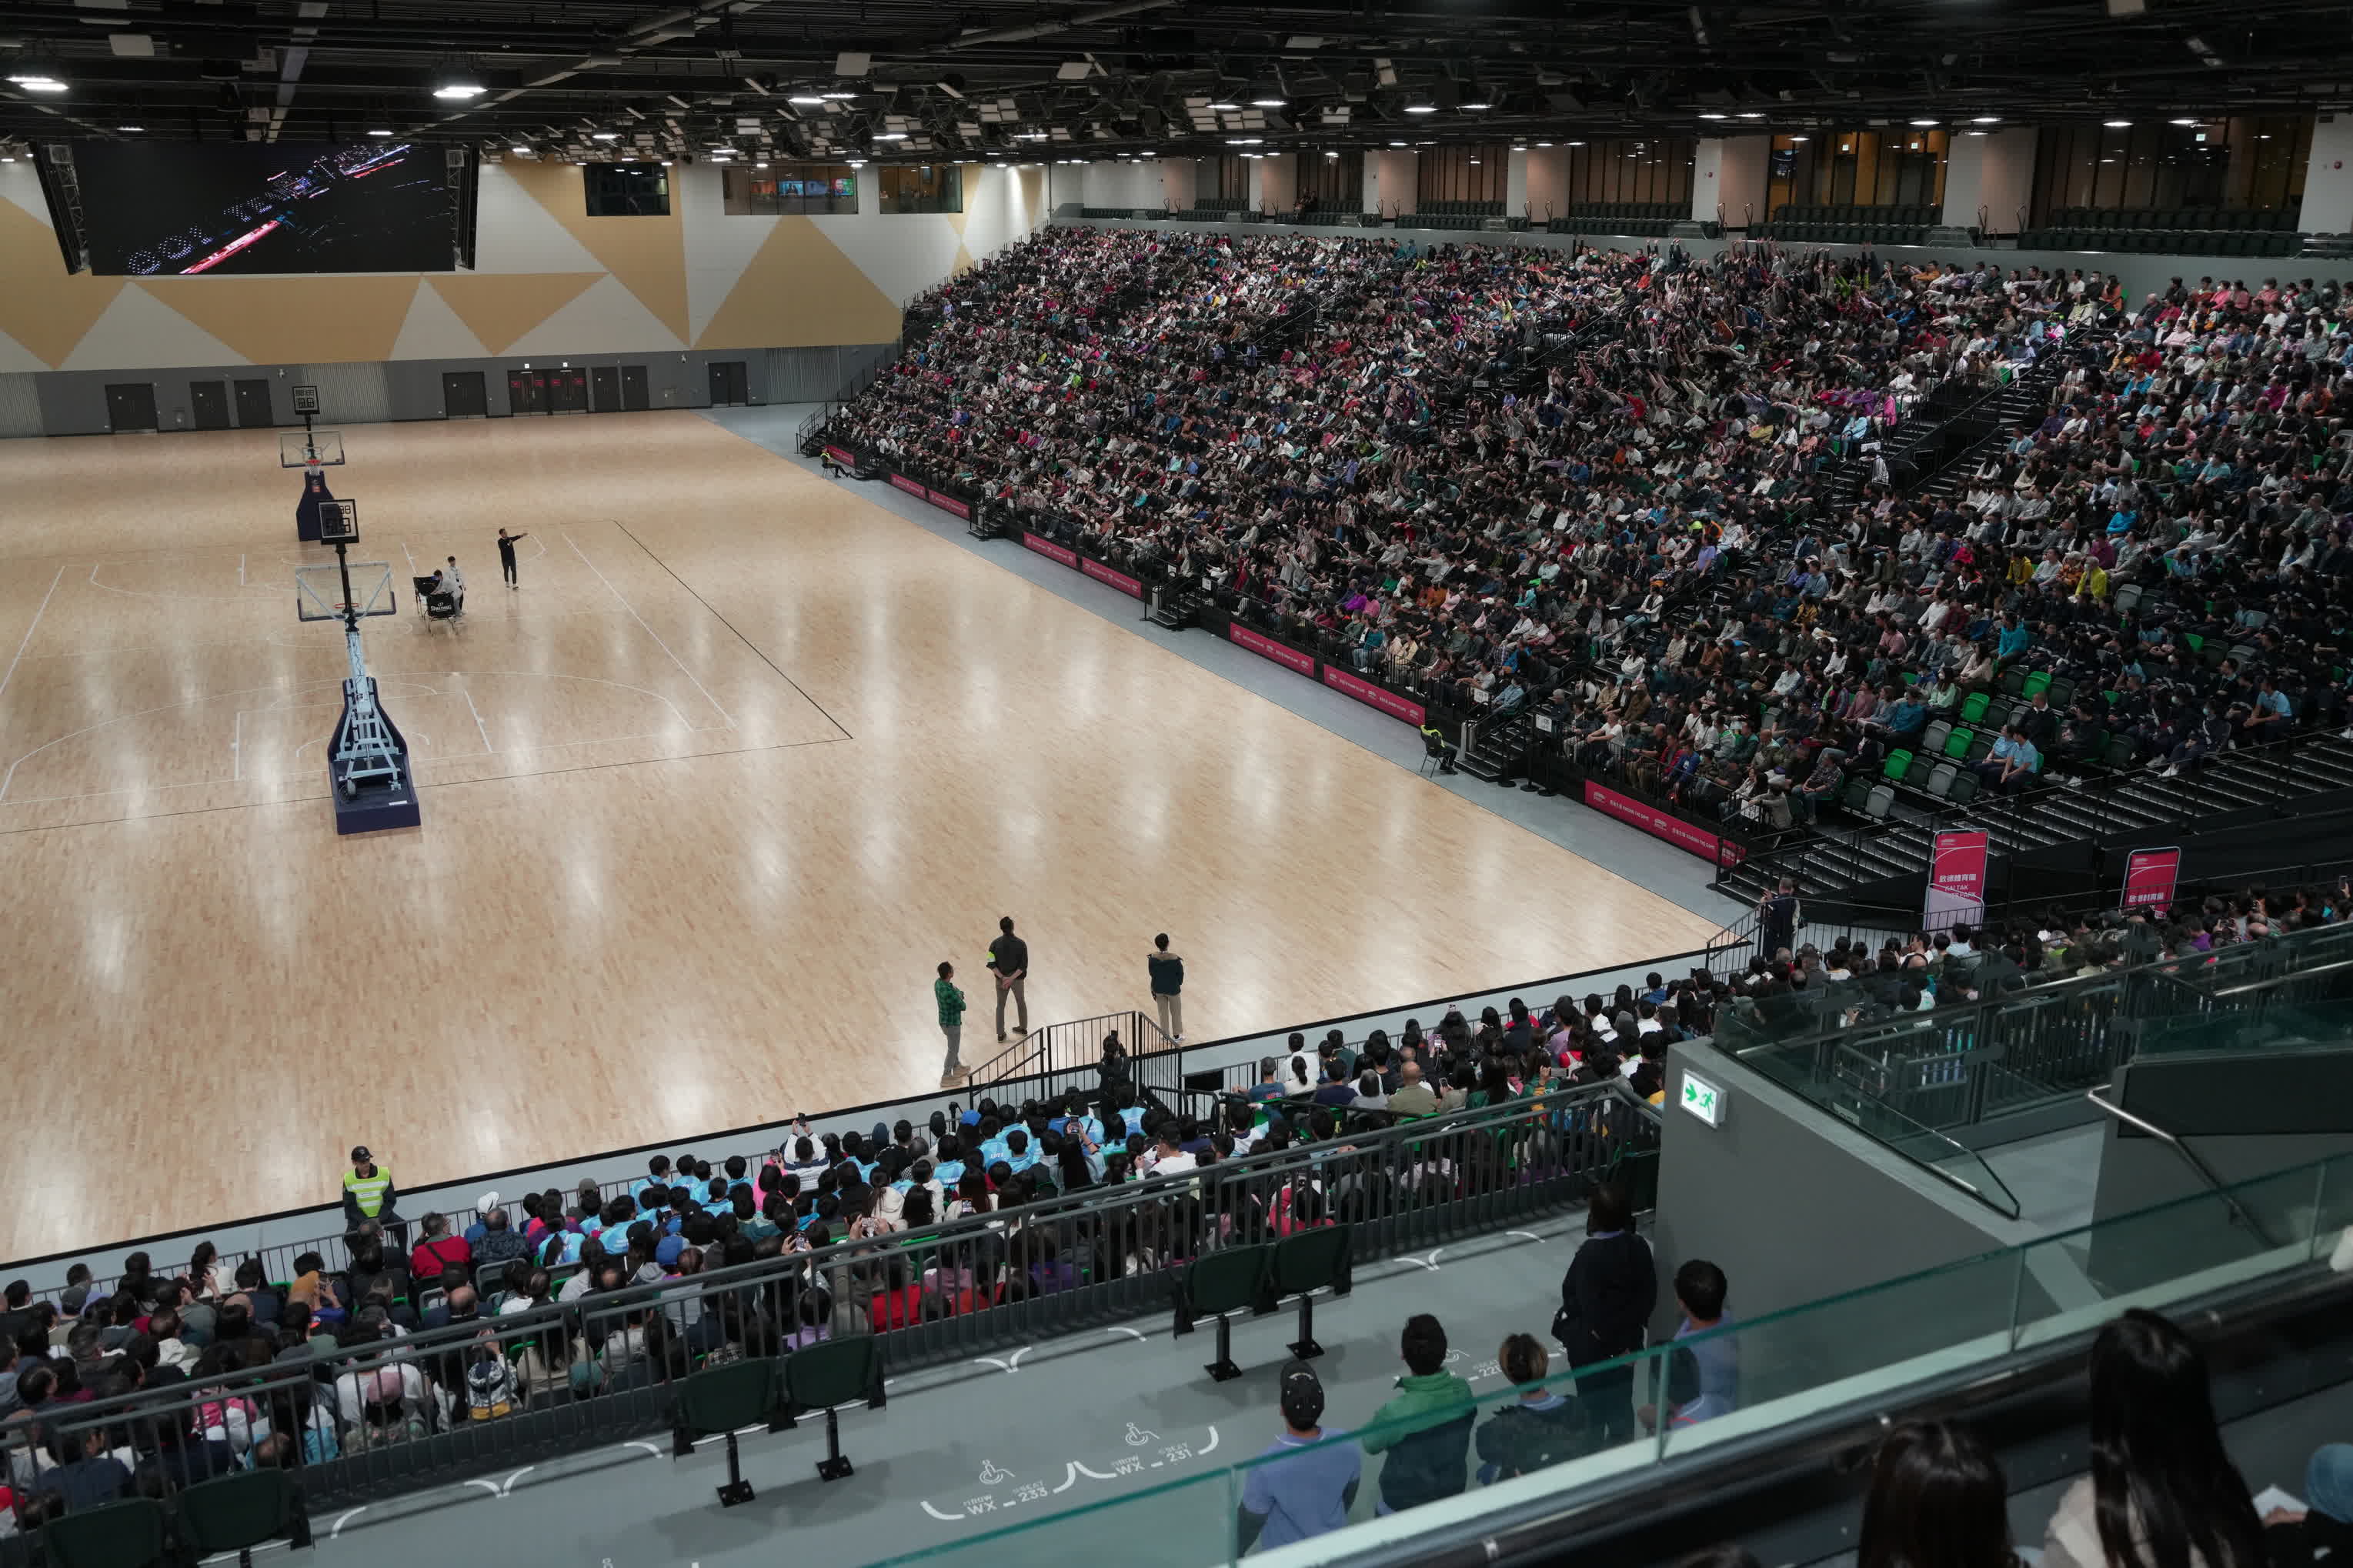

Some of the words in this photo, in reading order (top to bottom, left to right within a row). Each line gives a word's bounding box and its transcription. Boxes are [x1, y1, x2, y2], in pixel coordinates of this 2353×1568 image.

[1116, 1462, 1146, 1475] WX
[1166, 1449, 1193, 1463] 231
[966, 1501, 998, 1515] WX
